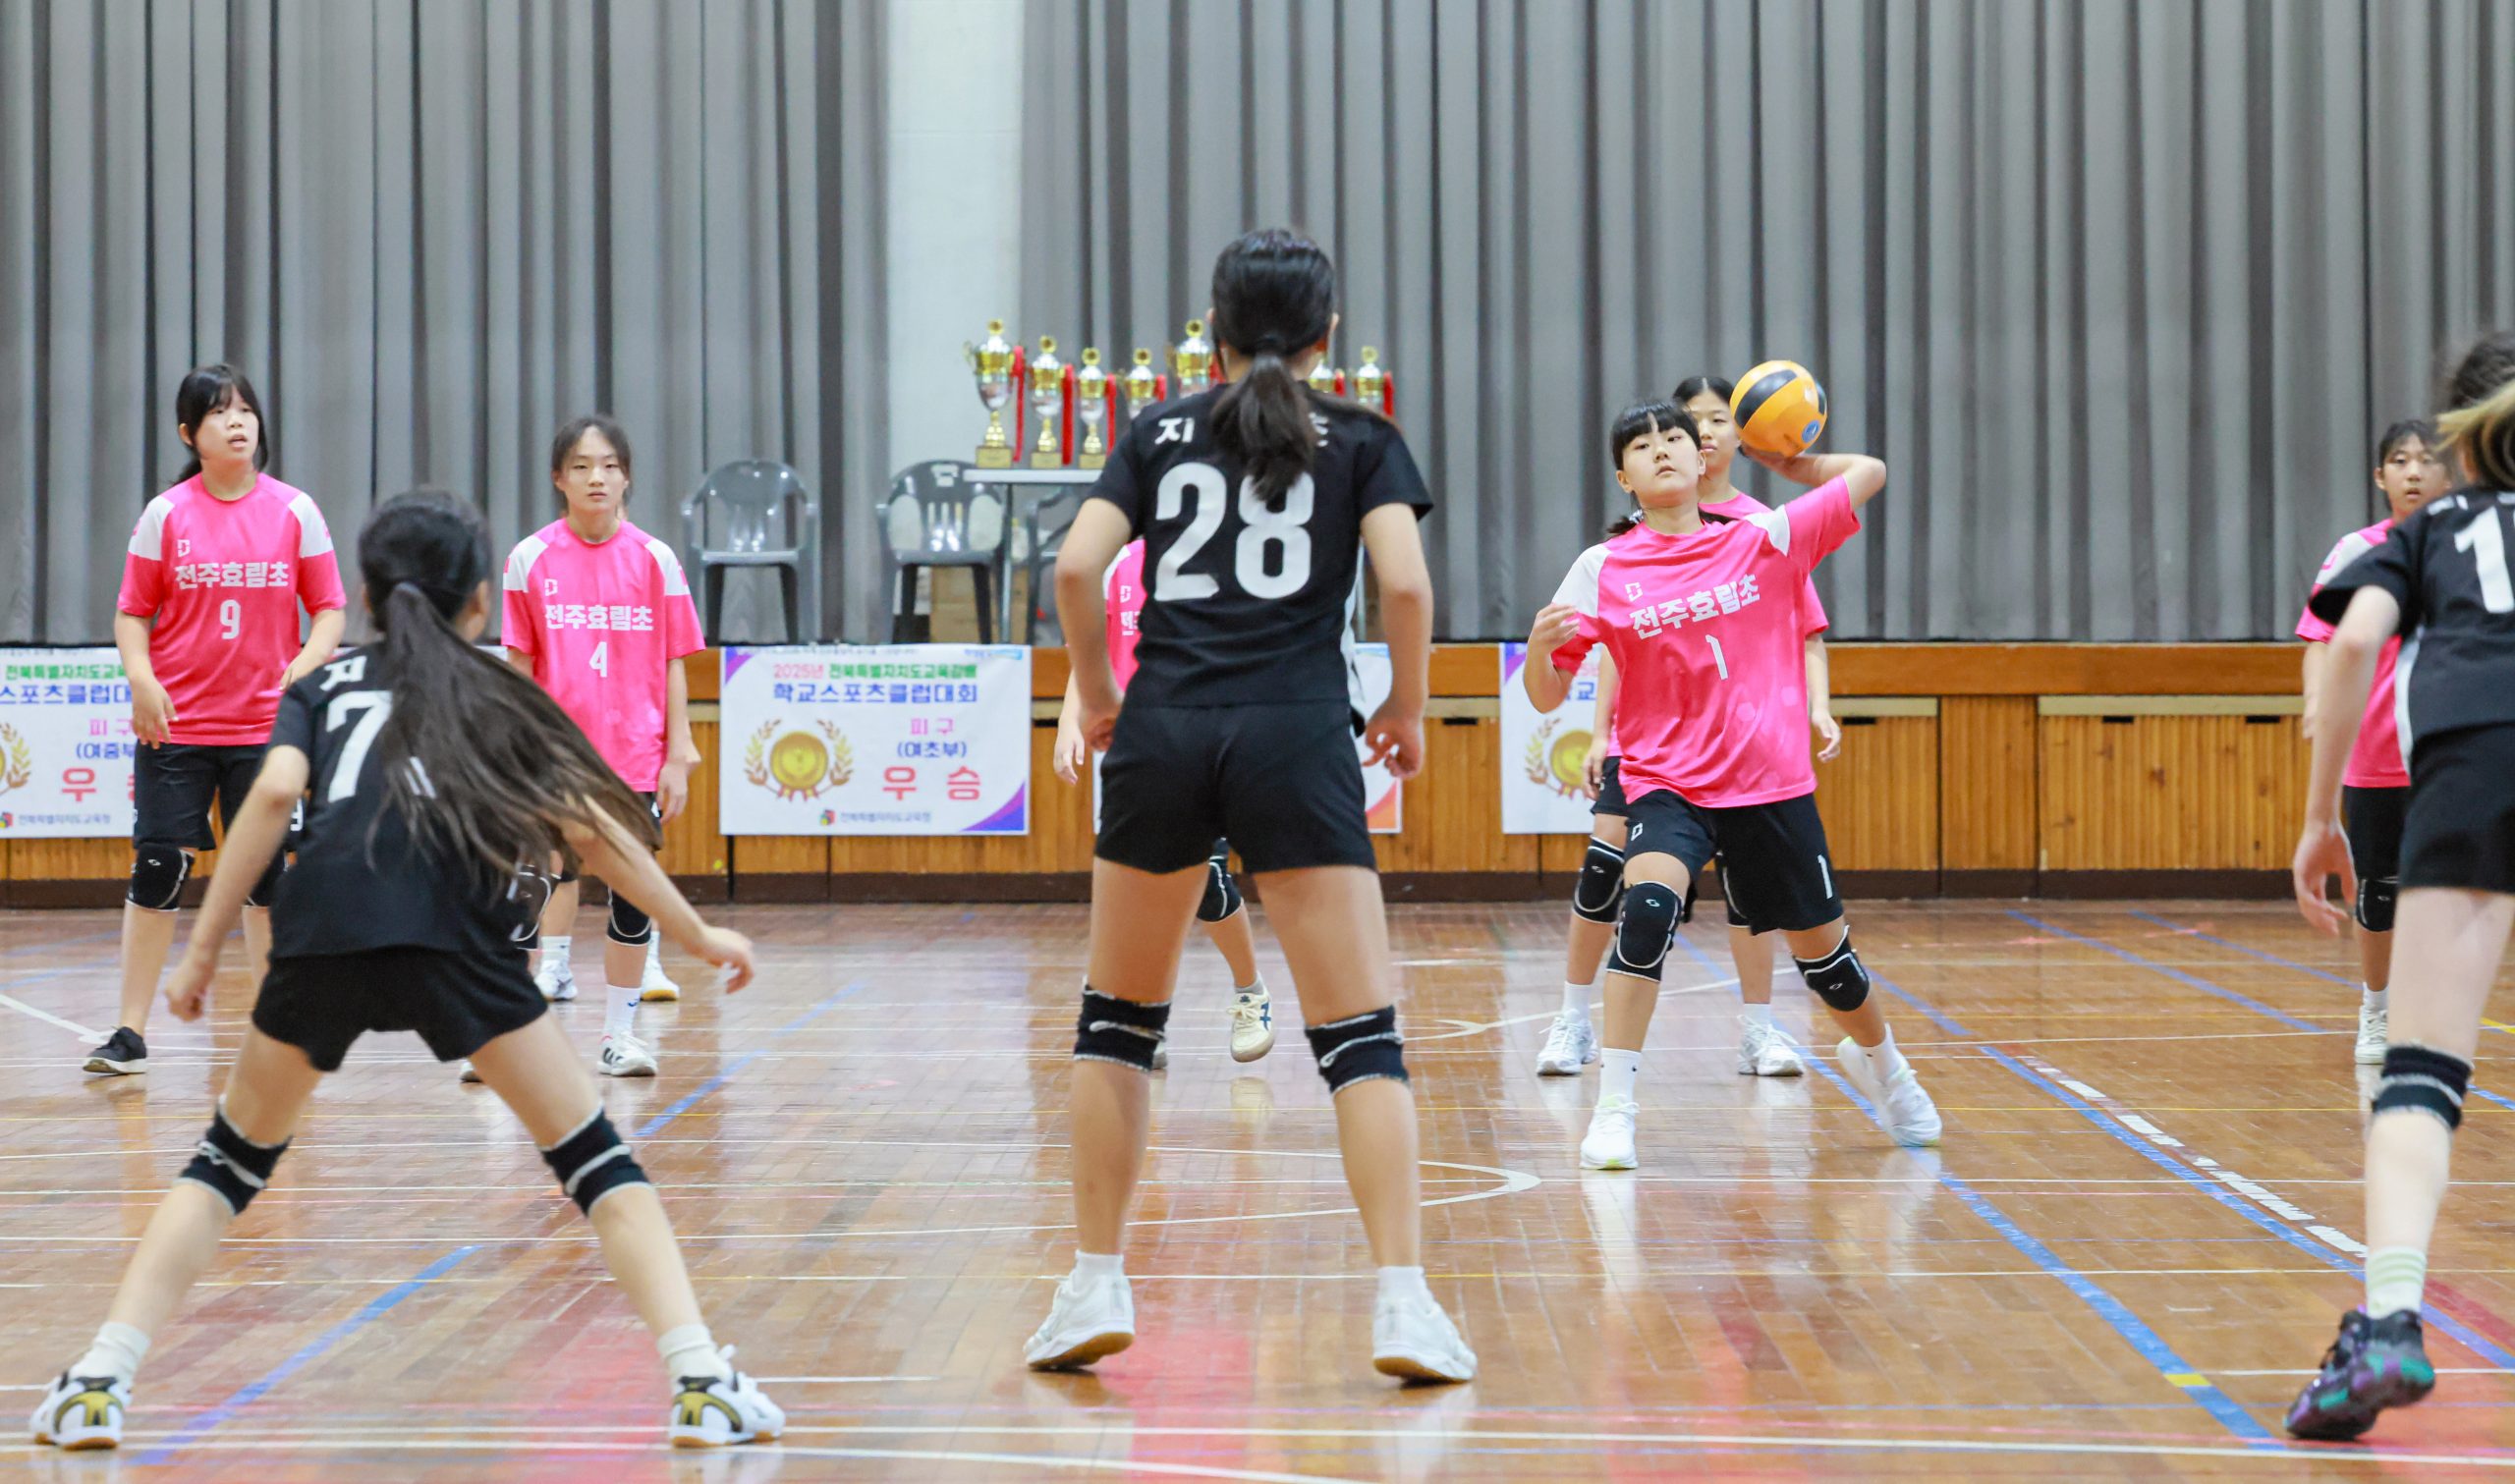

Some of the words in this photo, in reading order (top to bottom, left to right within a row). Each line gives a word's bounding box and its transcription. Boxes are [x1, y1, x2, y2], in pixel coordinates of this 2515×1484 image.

[1154, 462, 1314, 602] 28
[175, 561, 289, 590] 전주효림초
[219, 599, 241, 639] 9
[545, 604, 654, 632] 전주효림초
[1629, 574, 1760, 640] 전주효림초
[588, 640, 608, 678] 4
[1705, 633, 1729, 681] 1
[773, 683, 978, 704] 학교스포츠클럽대회
[896, 741, 968, 759] (여초부)
[1816, 854, 1834, 900] 1
